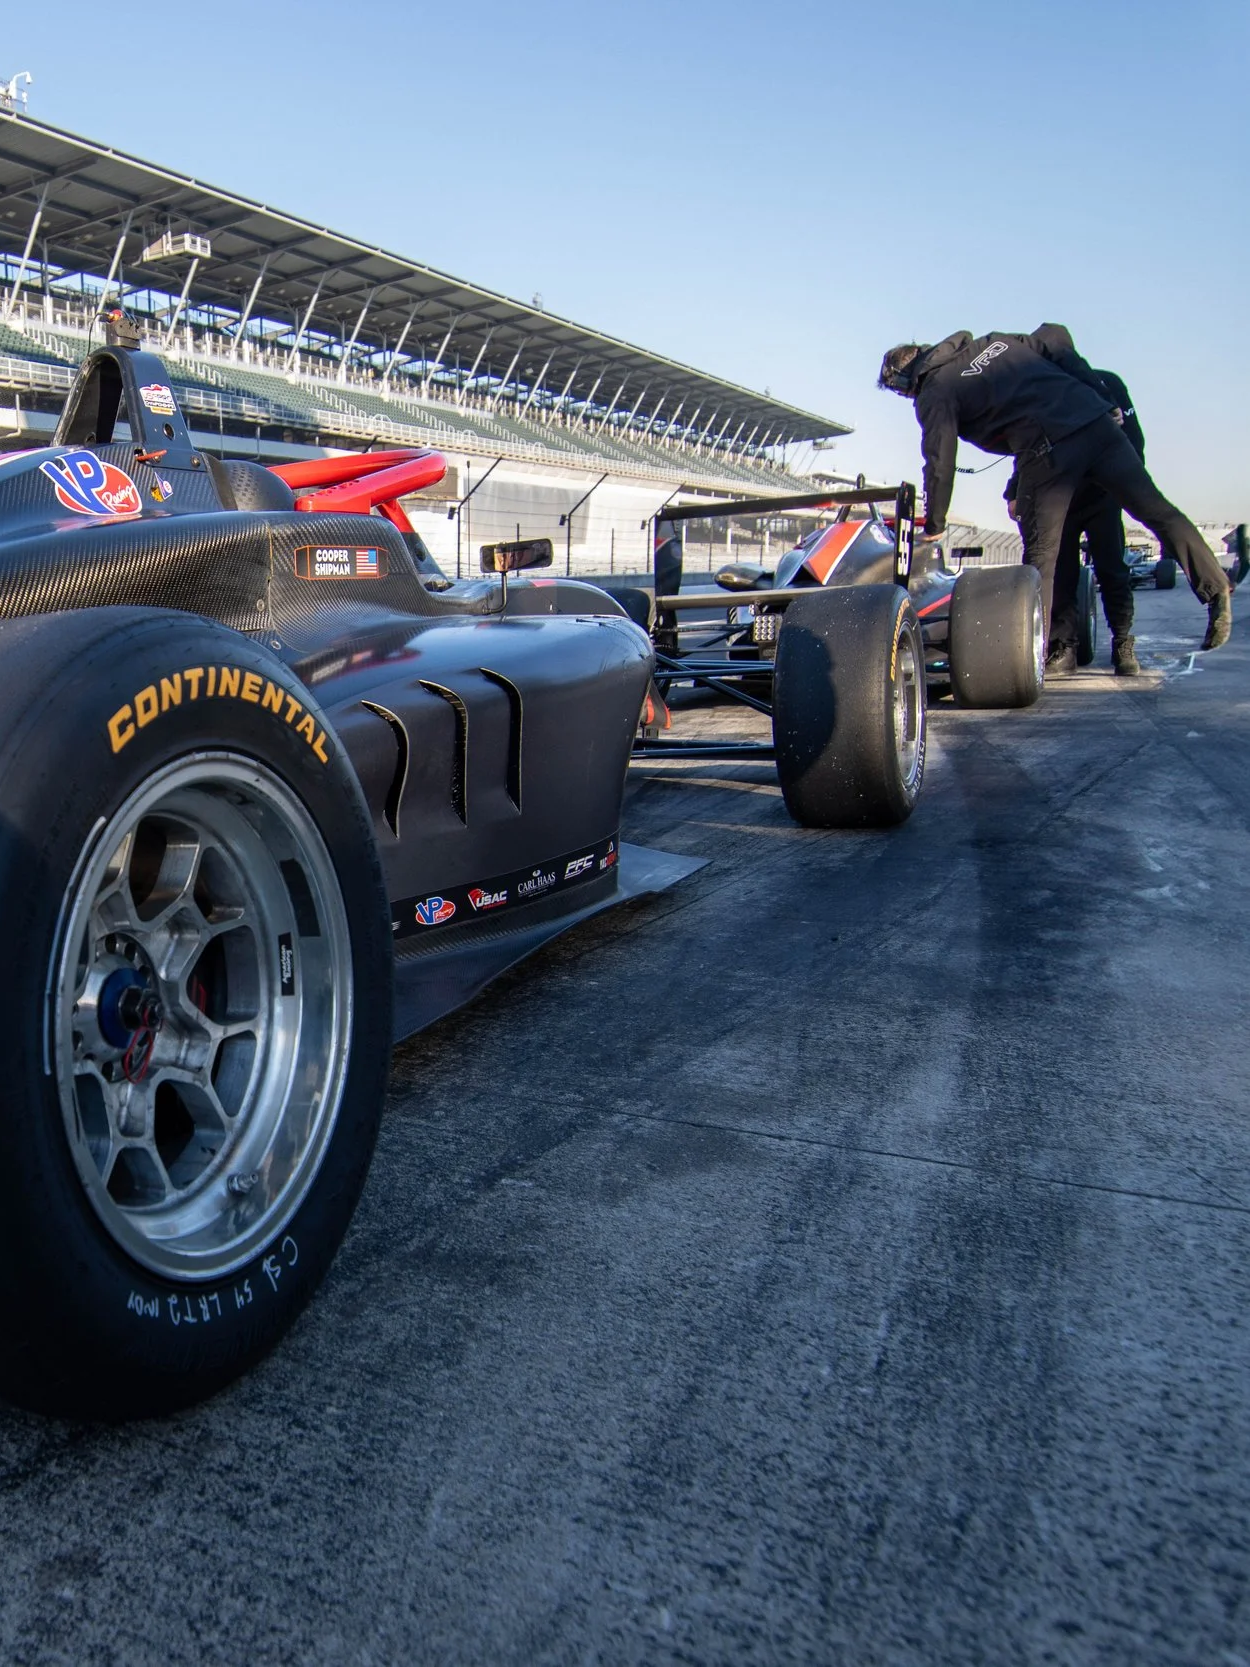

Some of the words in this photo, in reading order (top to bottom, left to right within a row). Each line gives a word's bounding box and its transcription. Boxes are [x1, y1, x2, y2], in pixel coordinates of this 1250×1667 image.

[39, 450, 108, 515] VP
[101, 483, 136, 511] Racing
[315, 549, 349, 562] COOPER
[315, 563, 351, 576] SHIPMAN
[107, 666, 329, 764] CONTINENTAL
[565, 854, 595, 875] PFC
[517, 878, 537, 893] CARL
[537, 871, 556, 887] HAAS
[476, 890, 508, 908] USAC
[416, 896, 444, 925] VP
